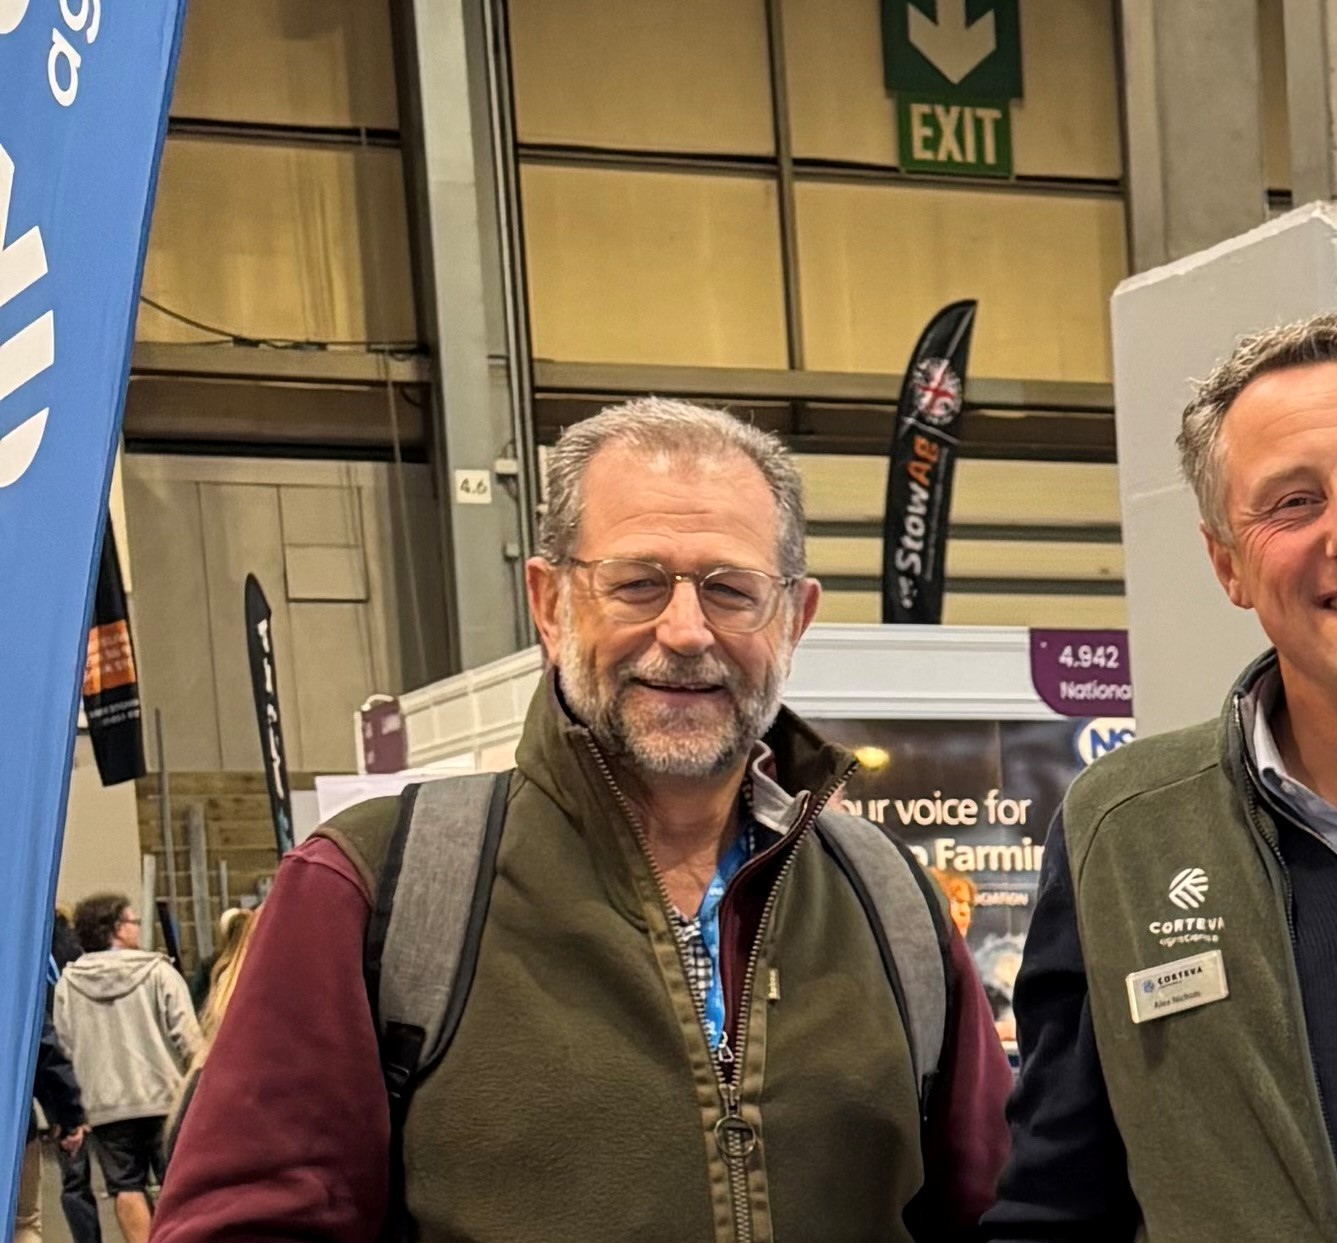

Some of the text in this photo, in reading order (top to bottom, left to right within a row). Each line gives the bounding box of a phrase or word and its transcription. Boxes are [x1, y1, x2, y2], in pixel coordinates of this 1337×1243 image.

[910, 103, 1002, 165] EXIT
[1059, 645, 1119, 669] 4.942
[895, 790, 979, 826] voice
[985, 789, 1032, 826] for
[1149, 916, 1225, 935] CORTEVA
[1157, 966, 1204, 985] CORTEVA
